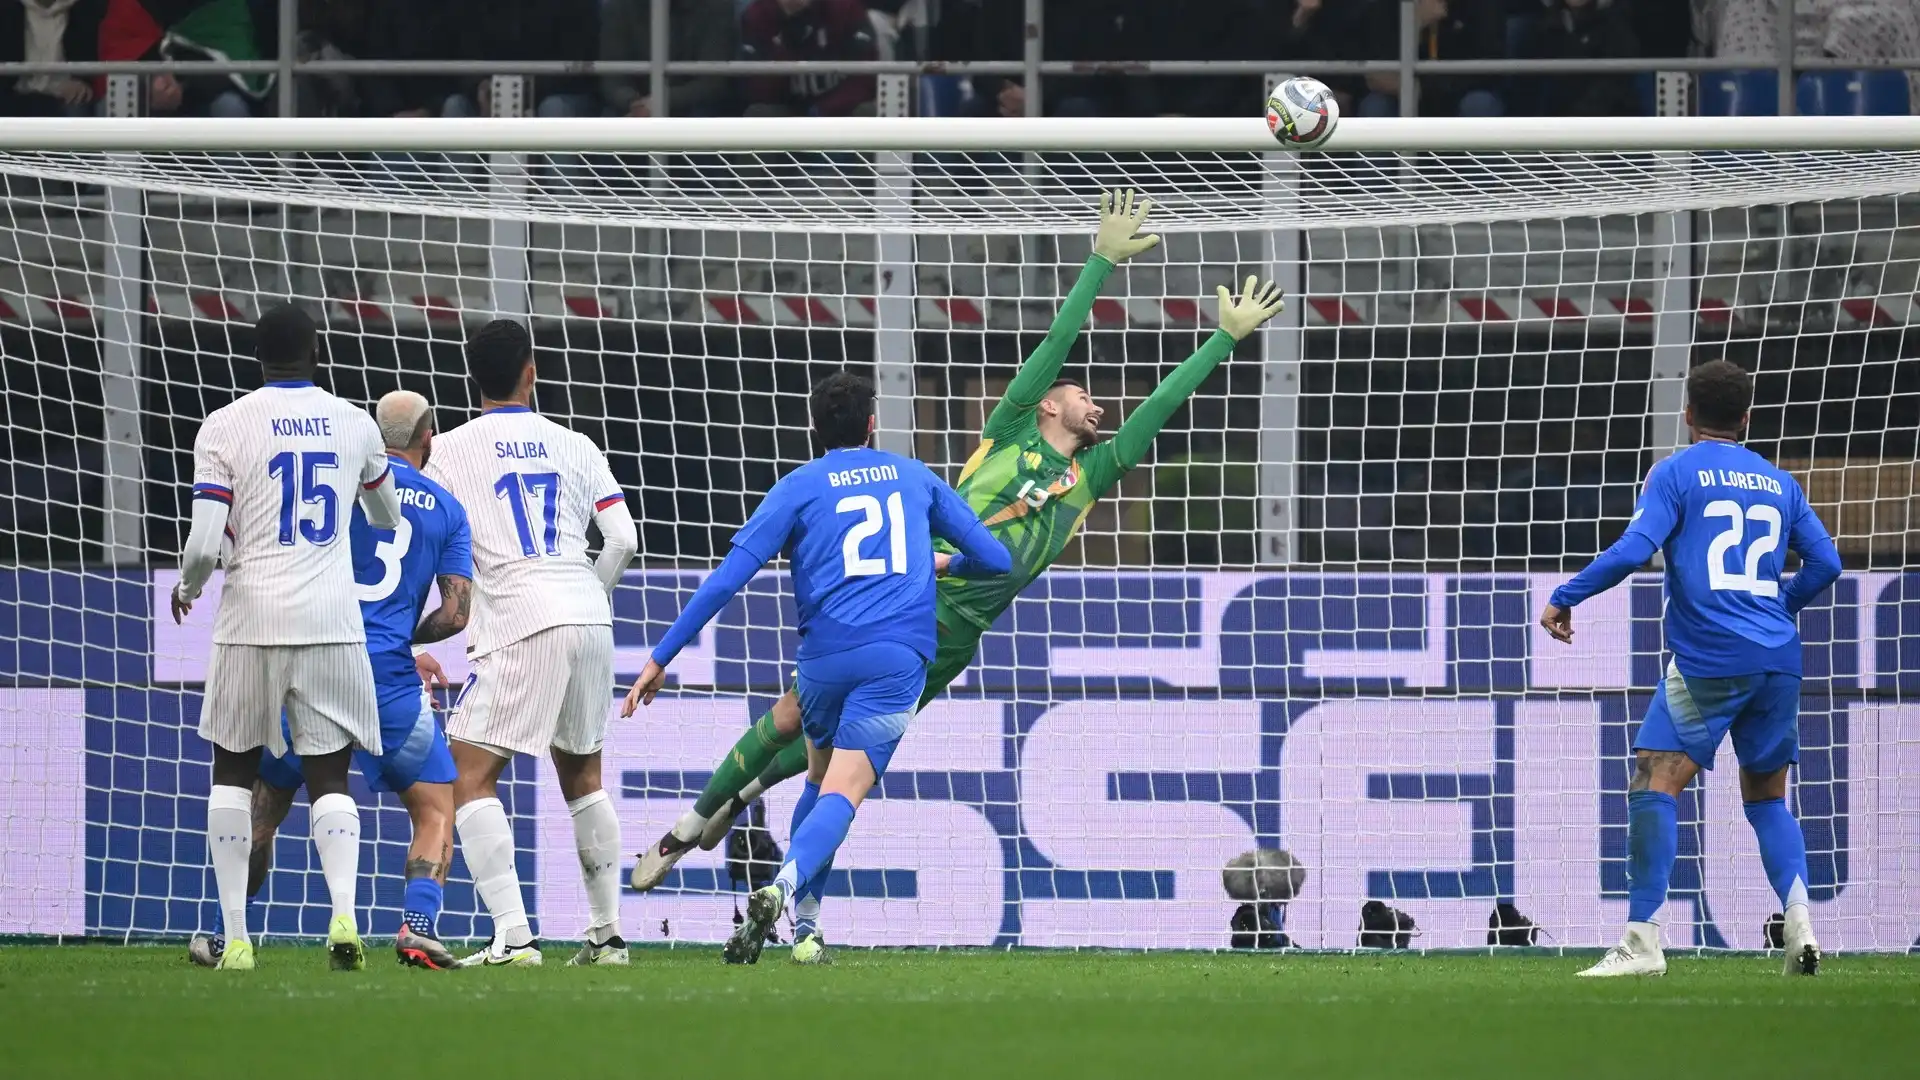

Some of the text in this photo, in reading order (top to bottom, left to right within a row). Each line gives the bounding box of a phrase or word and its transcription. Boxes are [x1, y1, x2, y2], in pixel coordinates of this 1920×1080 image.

[271, 416, 331, 437] KONATE
[494, 440, 548, 460] SALIBA
[267, 450, 340, 547] 15
[394, 487, 437, 511] ARCO
[828, 464, 899, 488] BASTONI
[1698, 469, 1783, 496] DI LORENZO
[493, 471, 562, 558] 17
[835, 491, 908, 579] 21
[354, 514, 413, 603] 3
[1703, 500, 1783, 598] 22
